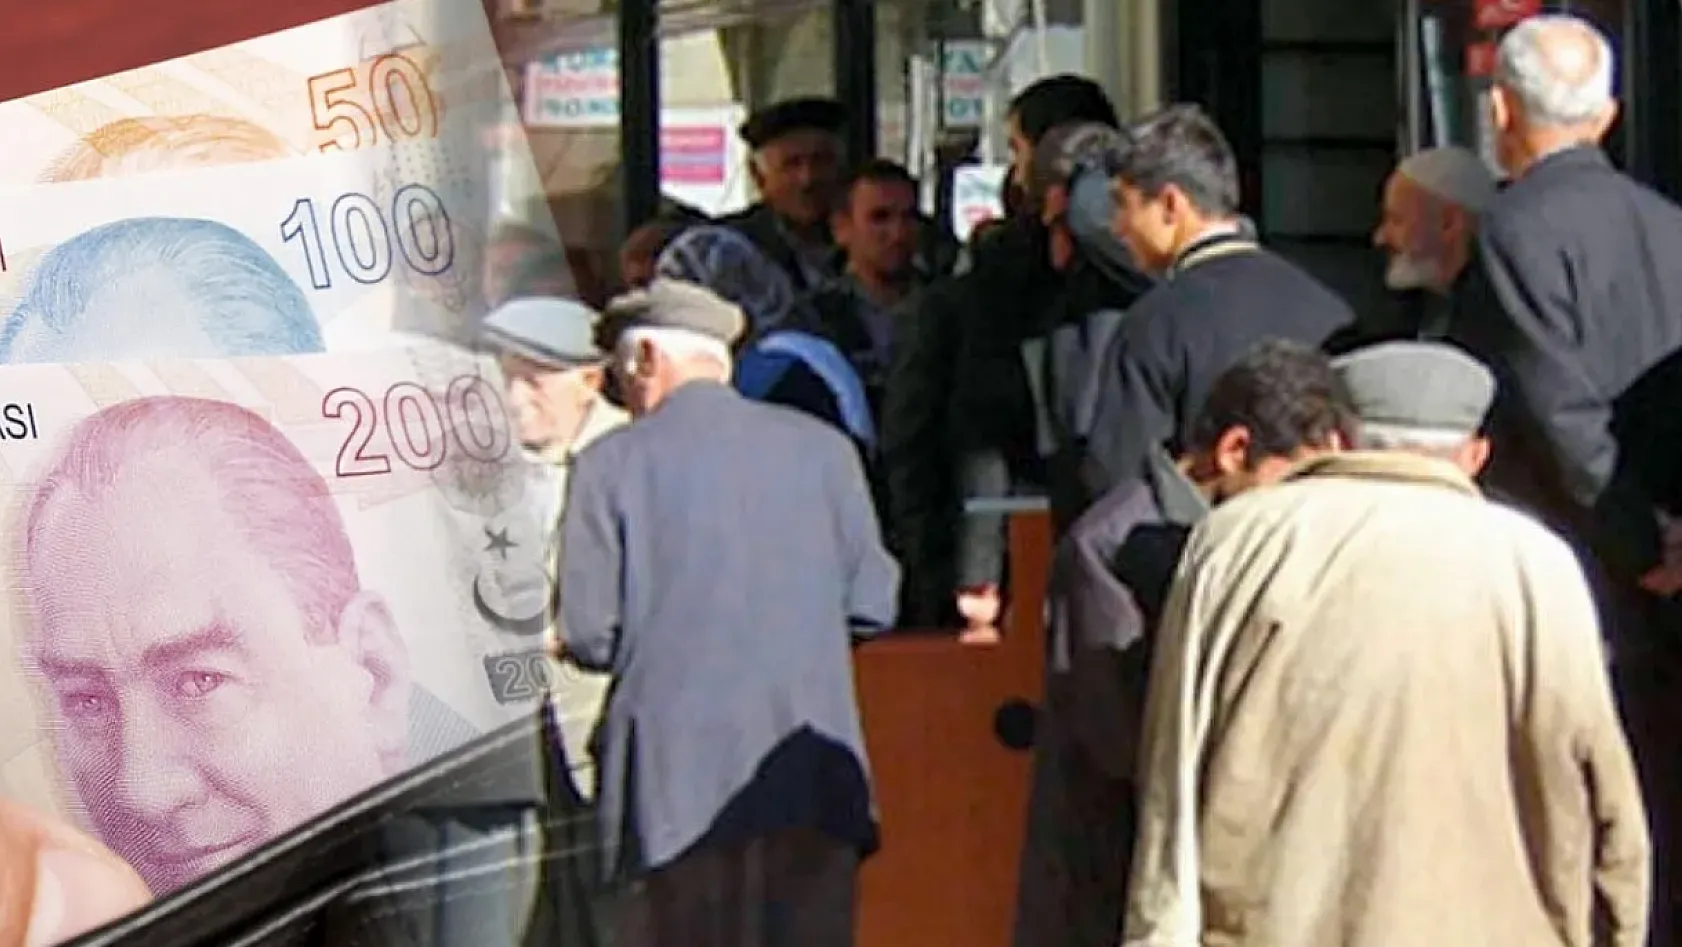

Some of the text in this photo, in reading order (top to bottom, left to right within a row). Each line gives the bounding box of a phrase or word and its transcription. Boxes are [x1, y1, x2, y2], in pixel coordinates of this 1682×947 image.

[308, 53, 438, 153] 50
[280, 182, 455, 290] 100
[0, 402, 38, 440] SI
[322, 374, 510, 477] 200
